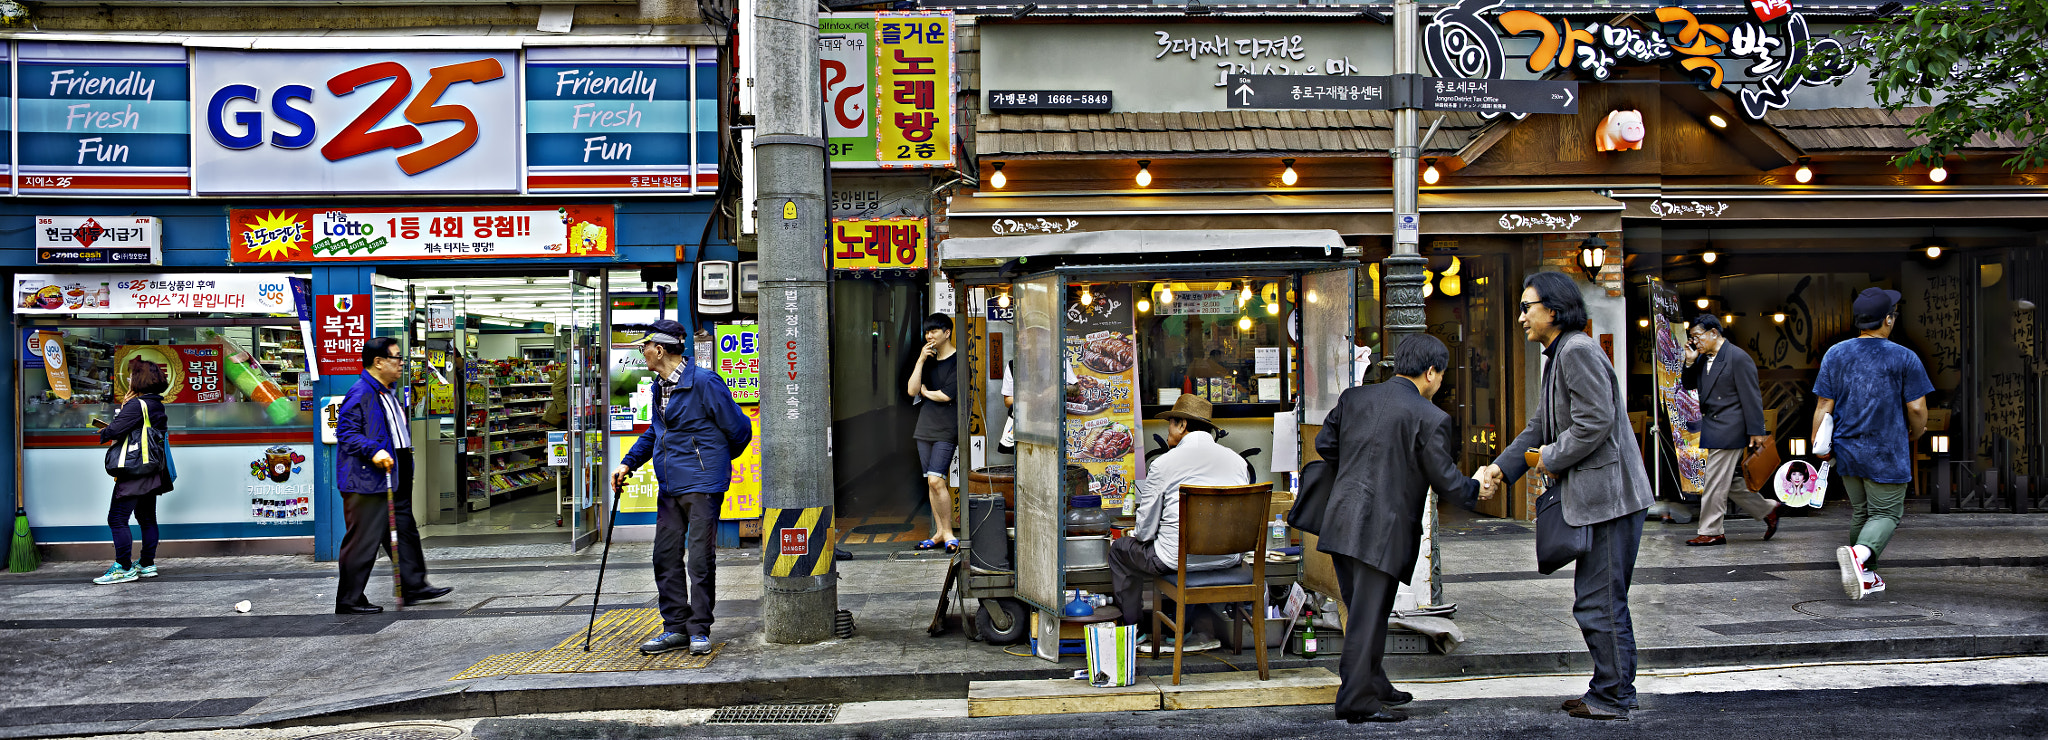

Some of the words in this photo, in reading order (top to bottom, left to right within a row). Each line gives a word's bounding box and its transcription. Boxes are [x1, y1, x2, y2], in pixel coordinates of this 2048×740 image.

[882, 23, 944, 44] 즐거운
[847, 39, 864, 51] 여우
[1154, 31, 1230, 60] 3대째
[1235, 34, 1306, 60] 다져온
[1655, 8, 1782, 88] 족발
[51, 70, 155, 103] Friendly
[556, 70, 656, 102] Friendly
[1290, 85, 1383, 101] 종로구재활용센터
[1434, 81, 1488, 94] 종로세무서
[893, 49, 940, 143] 노래방
[993, 93, 1038, 105] 가맹문의
[1047, 94, 1108, 104] 1666-5849
[66, 103, 139, 130] Fresh
[205, 57, 505, 176] GS25
[572, 103, 642, 129] Fresh
[77, 138, 129, 164] Fun
[583, 136, 632, 162] Fun
[829, 144, 854, 155] 3F
[25, 176, 55, 187] 지에스
[56, 176, 73, 188] 25
[629, 176, 682, 188] 종로낙원점
[326, 212, 348, 222] 나눔
[45, 227, 144, 242] 현금자동지급기
[324, 221, 373, 236] Lotto
[387, 217, 420, 239] 1등
[429, 216, 463, 238] 4회
[473, 215, 530, 238] 당첨!!
[424, 242, 442, 253] 계속
[443, 242, 470, 253] 터지는
[837, 225, 921, 265] 노래방
[117, 279, 149, 290] GS25
[149, 280, 195, 290] 히트상품의
[196, 280, 216, 289] 후예
[259, 283, 285, 297] you
[192, 293, 246, 309] 말입니다!
[993, 308, 1013, 319] 125
[323, 315, 365, 337] 복권
[324, 338, 365, 354] 판매점
[720, 331, 759, 354] 아토
[188, 361, 217, 375] 복권
[786, 341, 797, 380] CCTV
[188, 376, 219, 390] 명당
[727, 378, 760, 389] 바른자
